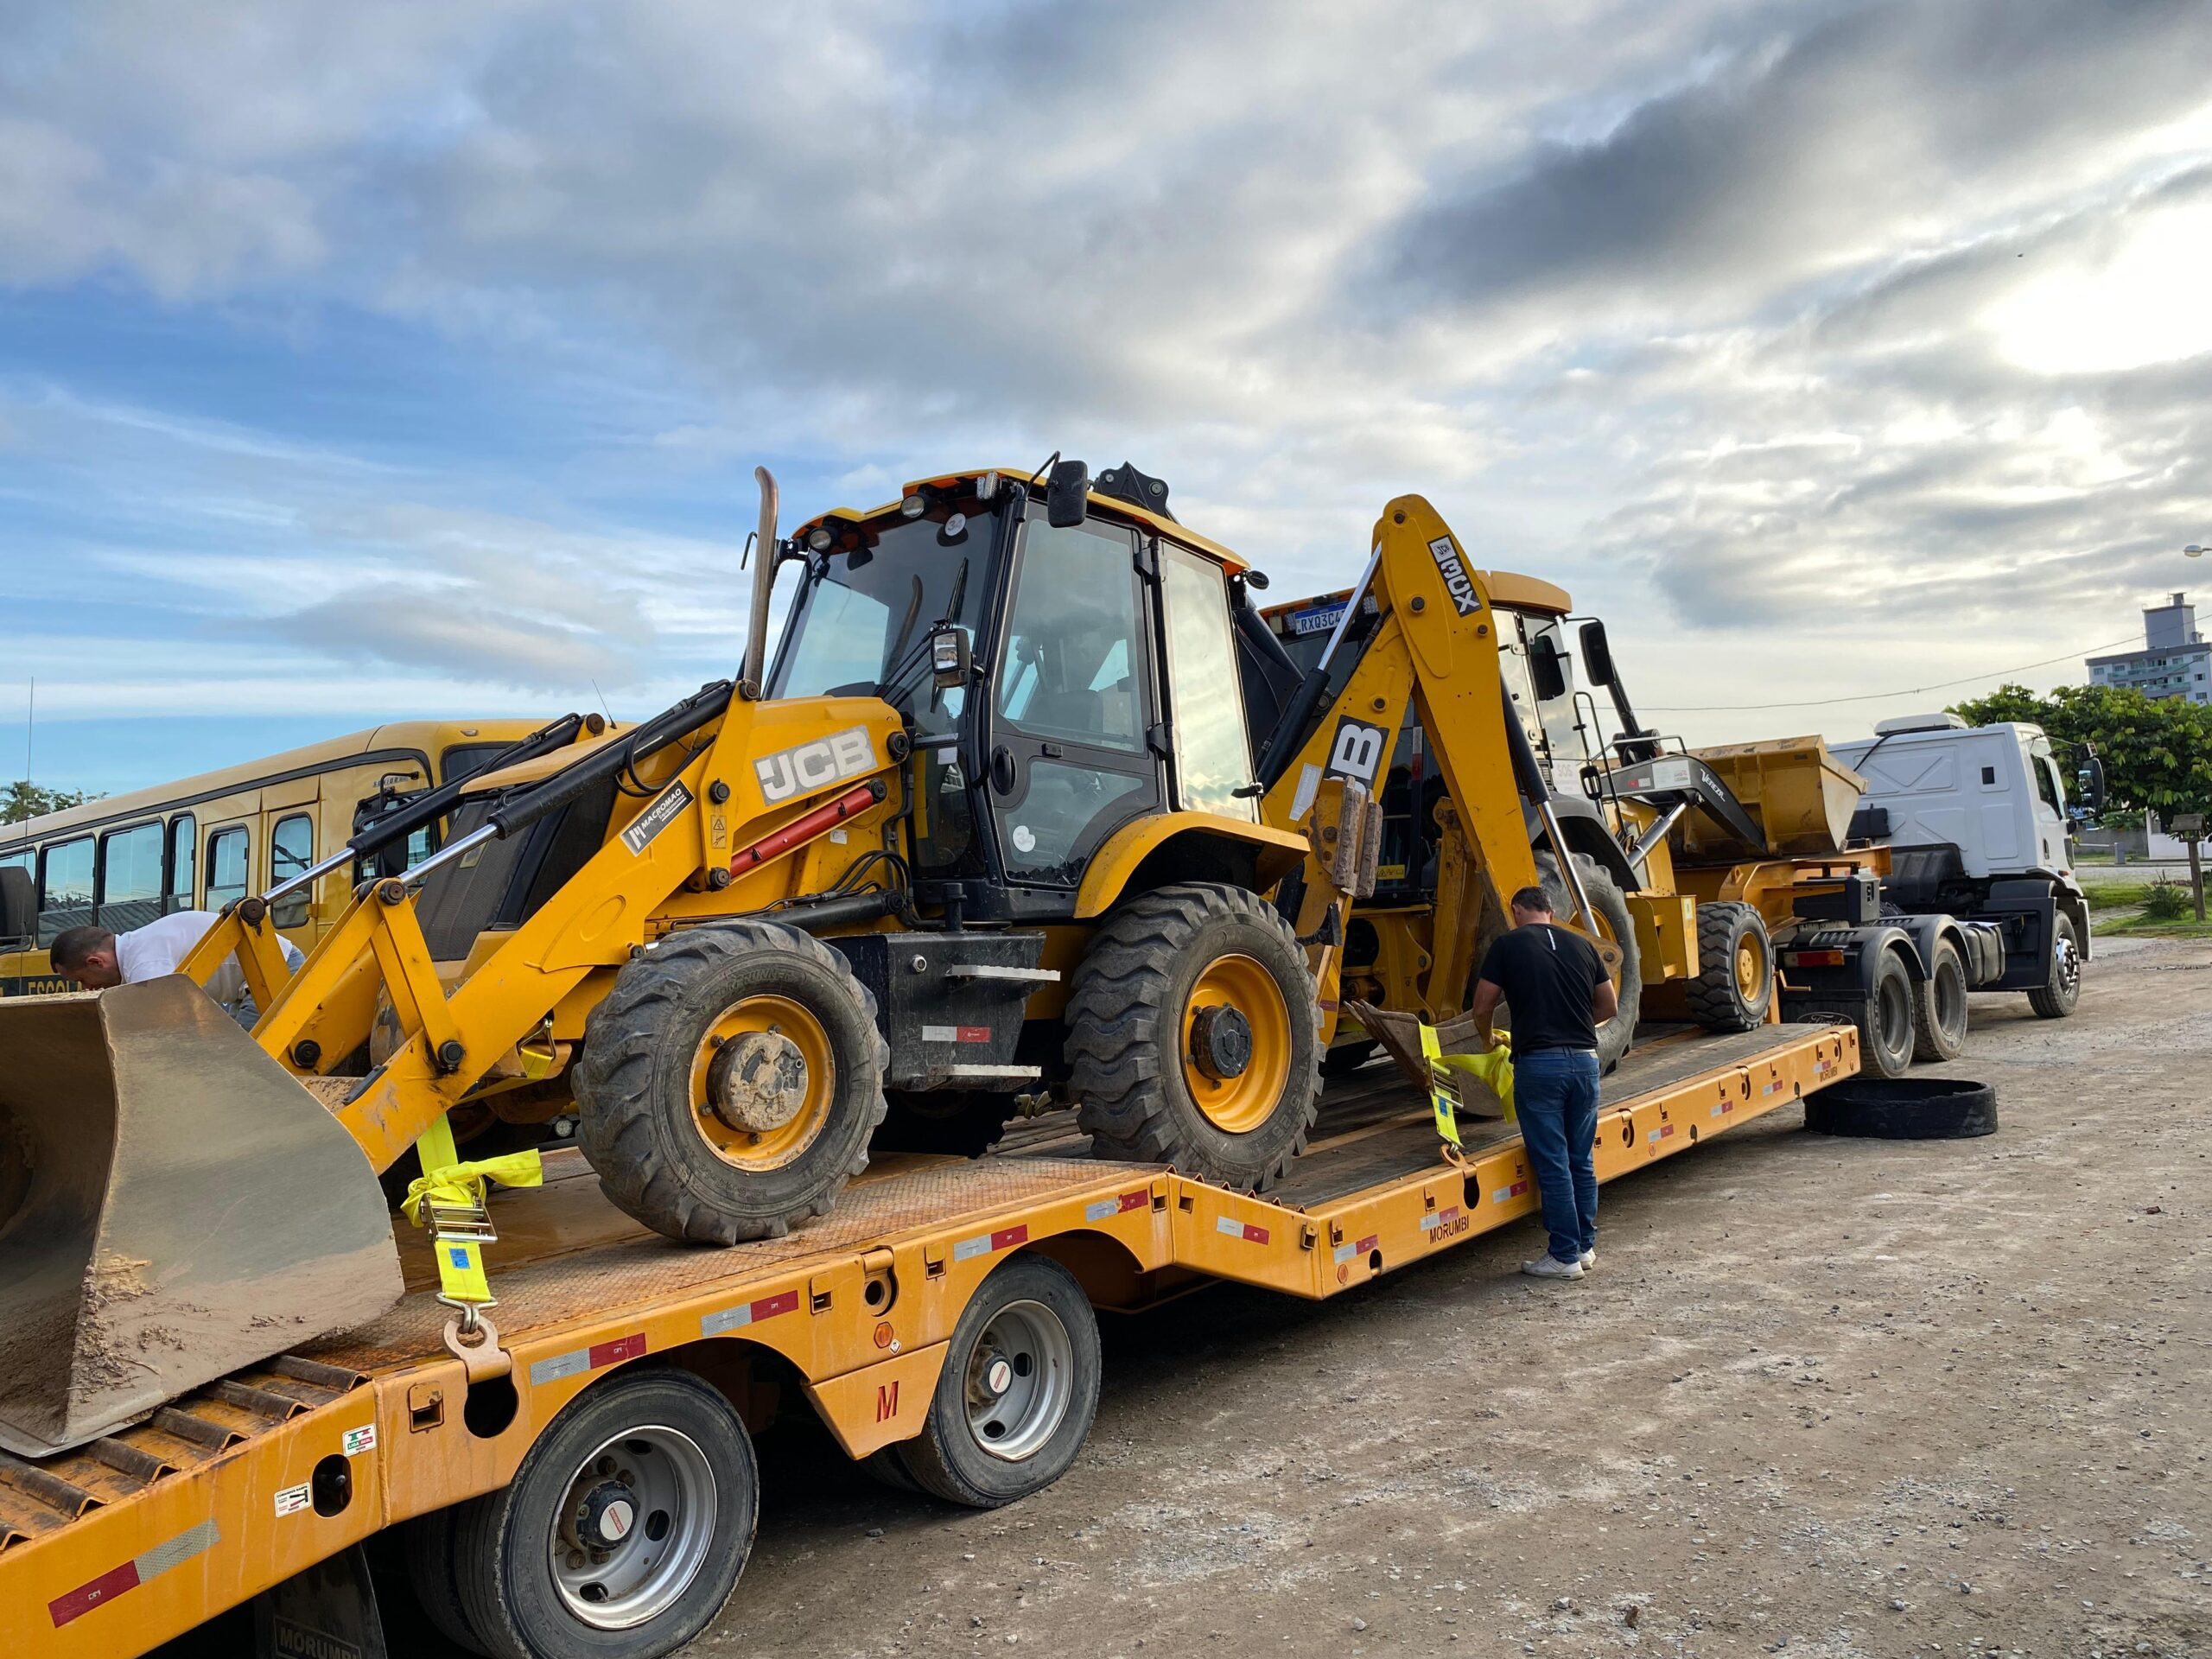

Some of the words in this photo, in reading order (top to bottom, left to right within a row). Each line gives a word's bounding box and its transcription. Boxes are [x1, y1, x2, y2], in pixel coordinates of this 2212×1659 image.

[1436, 544, 1452, 556] JCB
[1440, 558, 1480, 613] 3CX
[1300, 610, 1345, 632] RXQ3C4
[756, 731, 873, 800] JCB
[1330, 724, 1382, 788] B
[1429, 1214, 1469, 1245] MORUMBI
[875, 1380, 899, 1424] M
